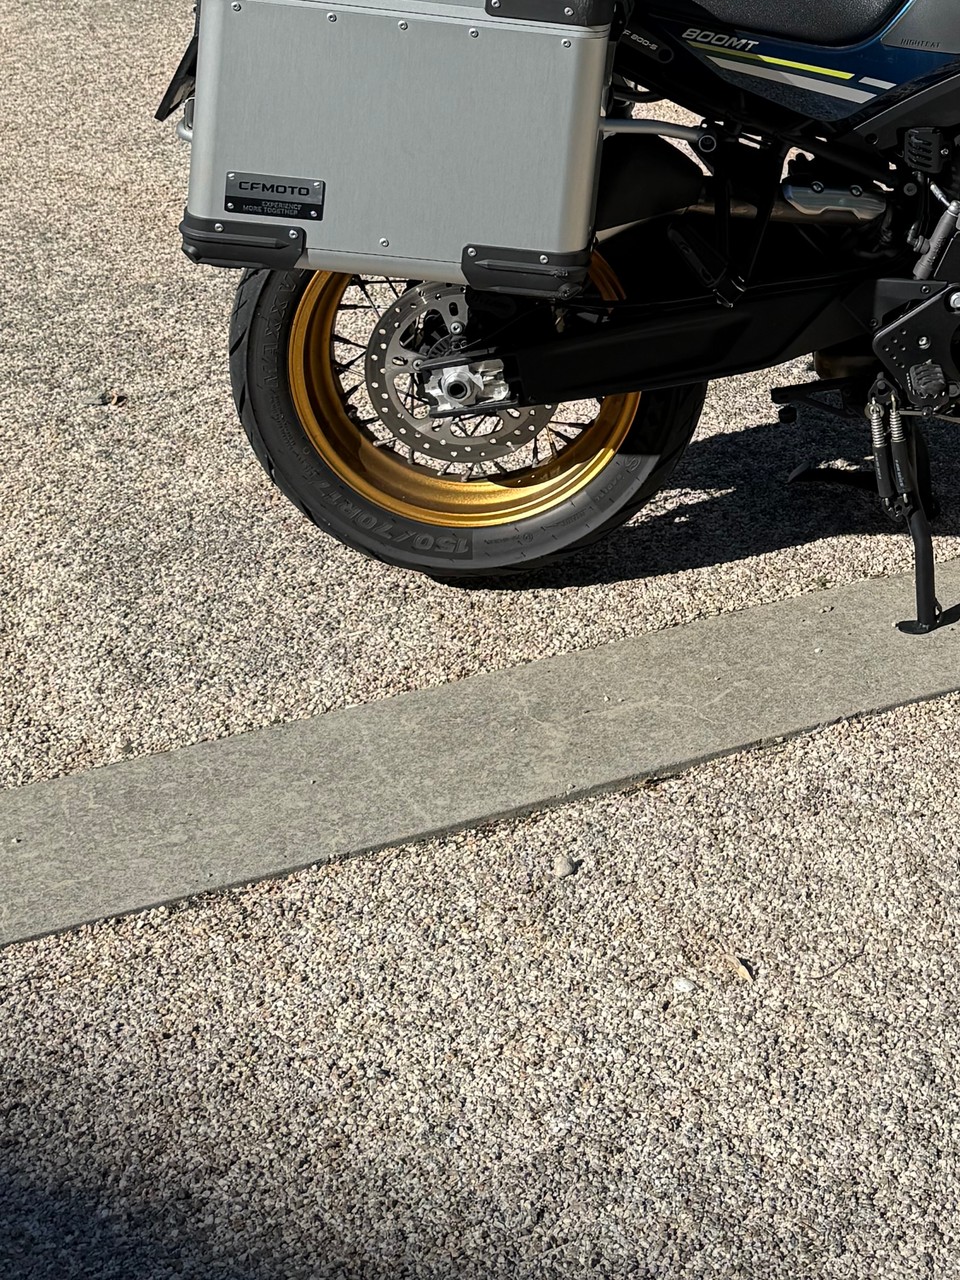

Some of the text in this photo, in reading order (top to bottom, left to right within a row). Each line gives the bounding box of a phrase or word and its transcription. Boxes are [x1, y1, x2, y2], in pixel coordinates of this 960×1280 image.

[681, 28, 759, 51] 800MT
[238, 181, 310, 196] CFMOTO
[243, 205, 298, 216] MORE TOGETHER
[262, 201, 302, 211] EXPERIENCE
